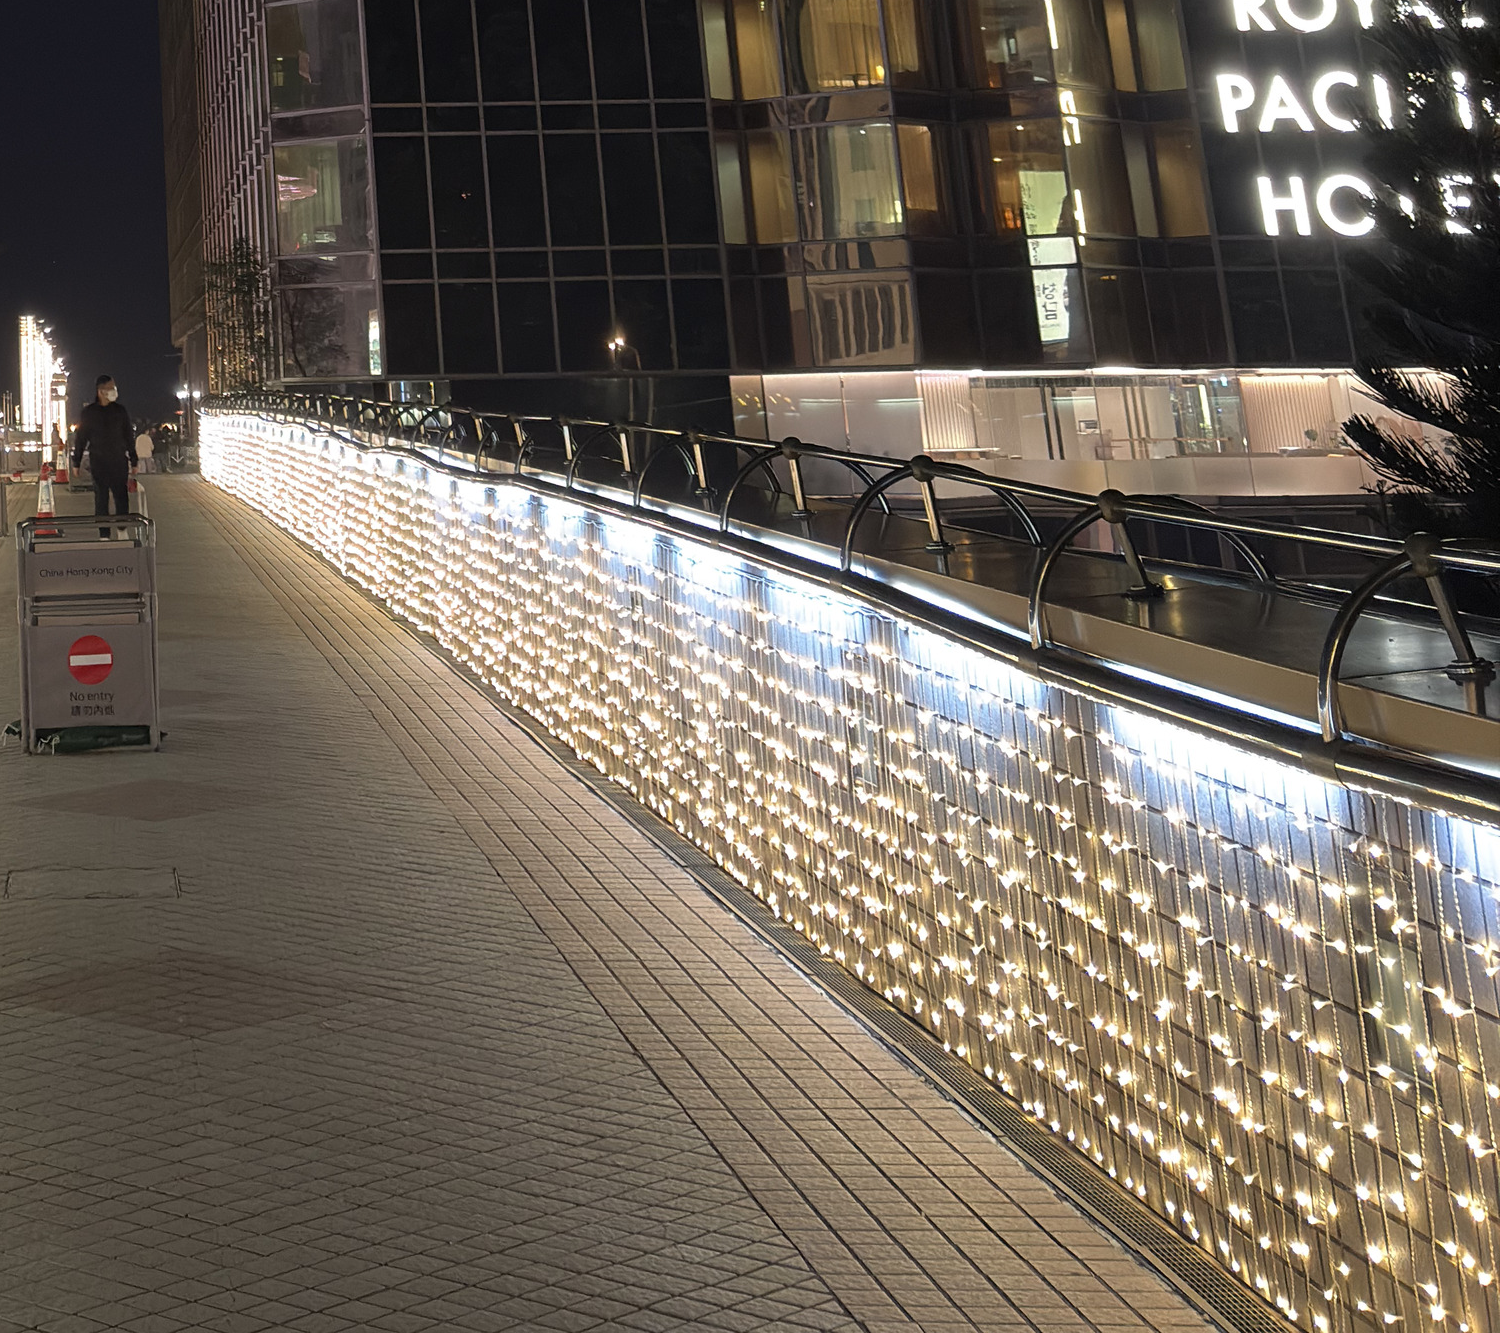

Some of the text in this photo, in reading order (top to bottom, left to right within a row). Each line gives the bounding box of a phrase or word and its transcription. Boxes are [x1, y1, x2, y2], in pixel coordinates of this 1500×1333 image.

[1215, 69, 1500, 134] PACII
[1256, 174, 1500, 238] HOE
[39, 566, 133, 578] China Hong Kong City
[69, 692, 114, 702] No entry
